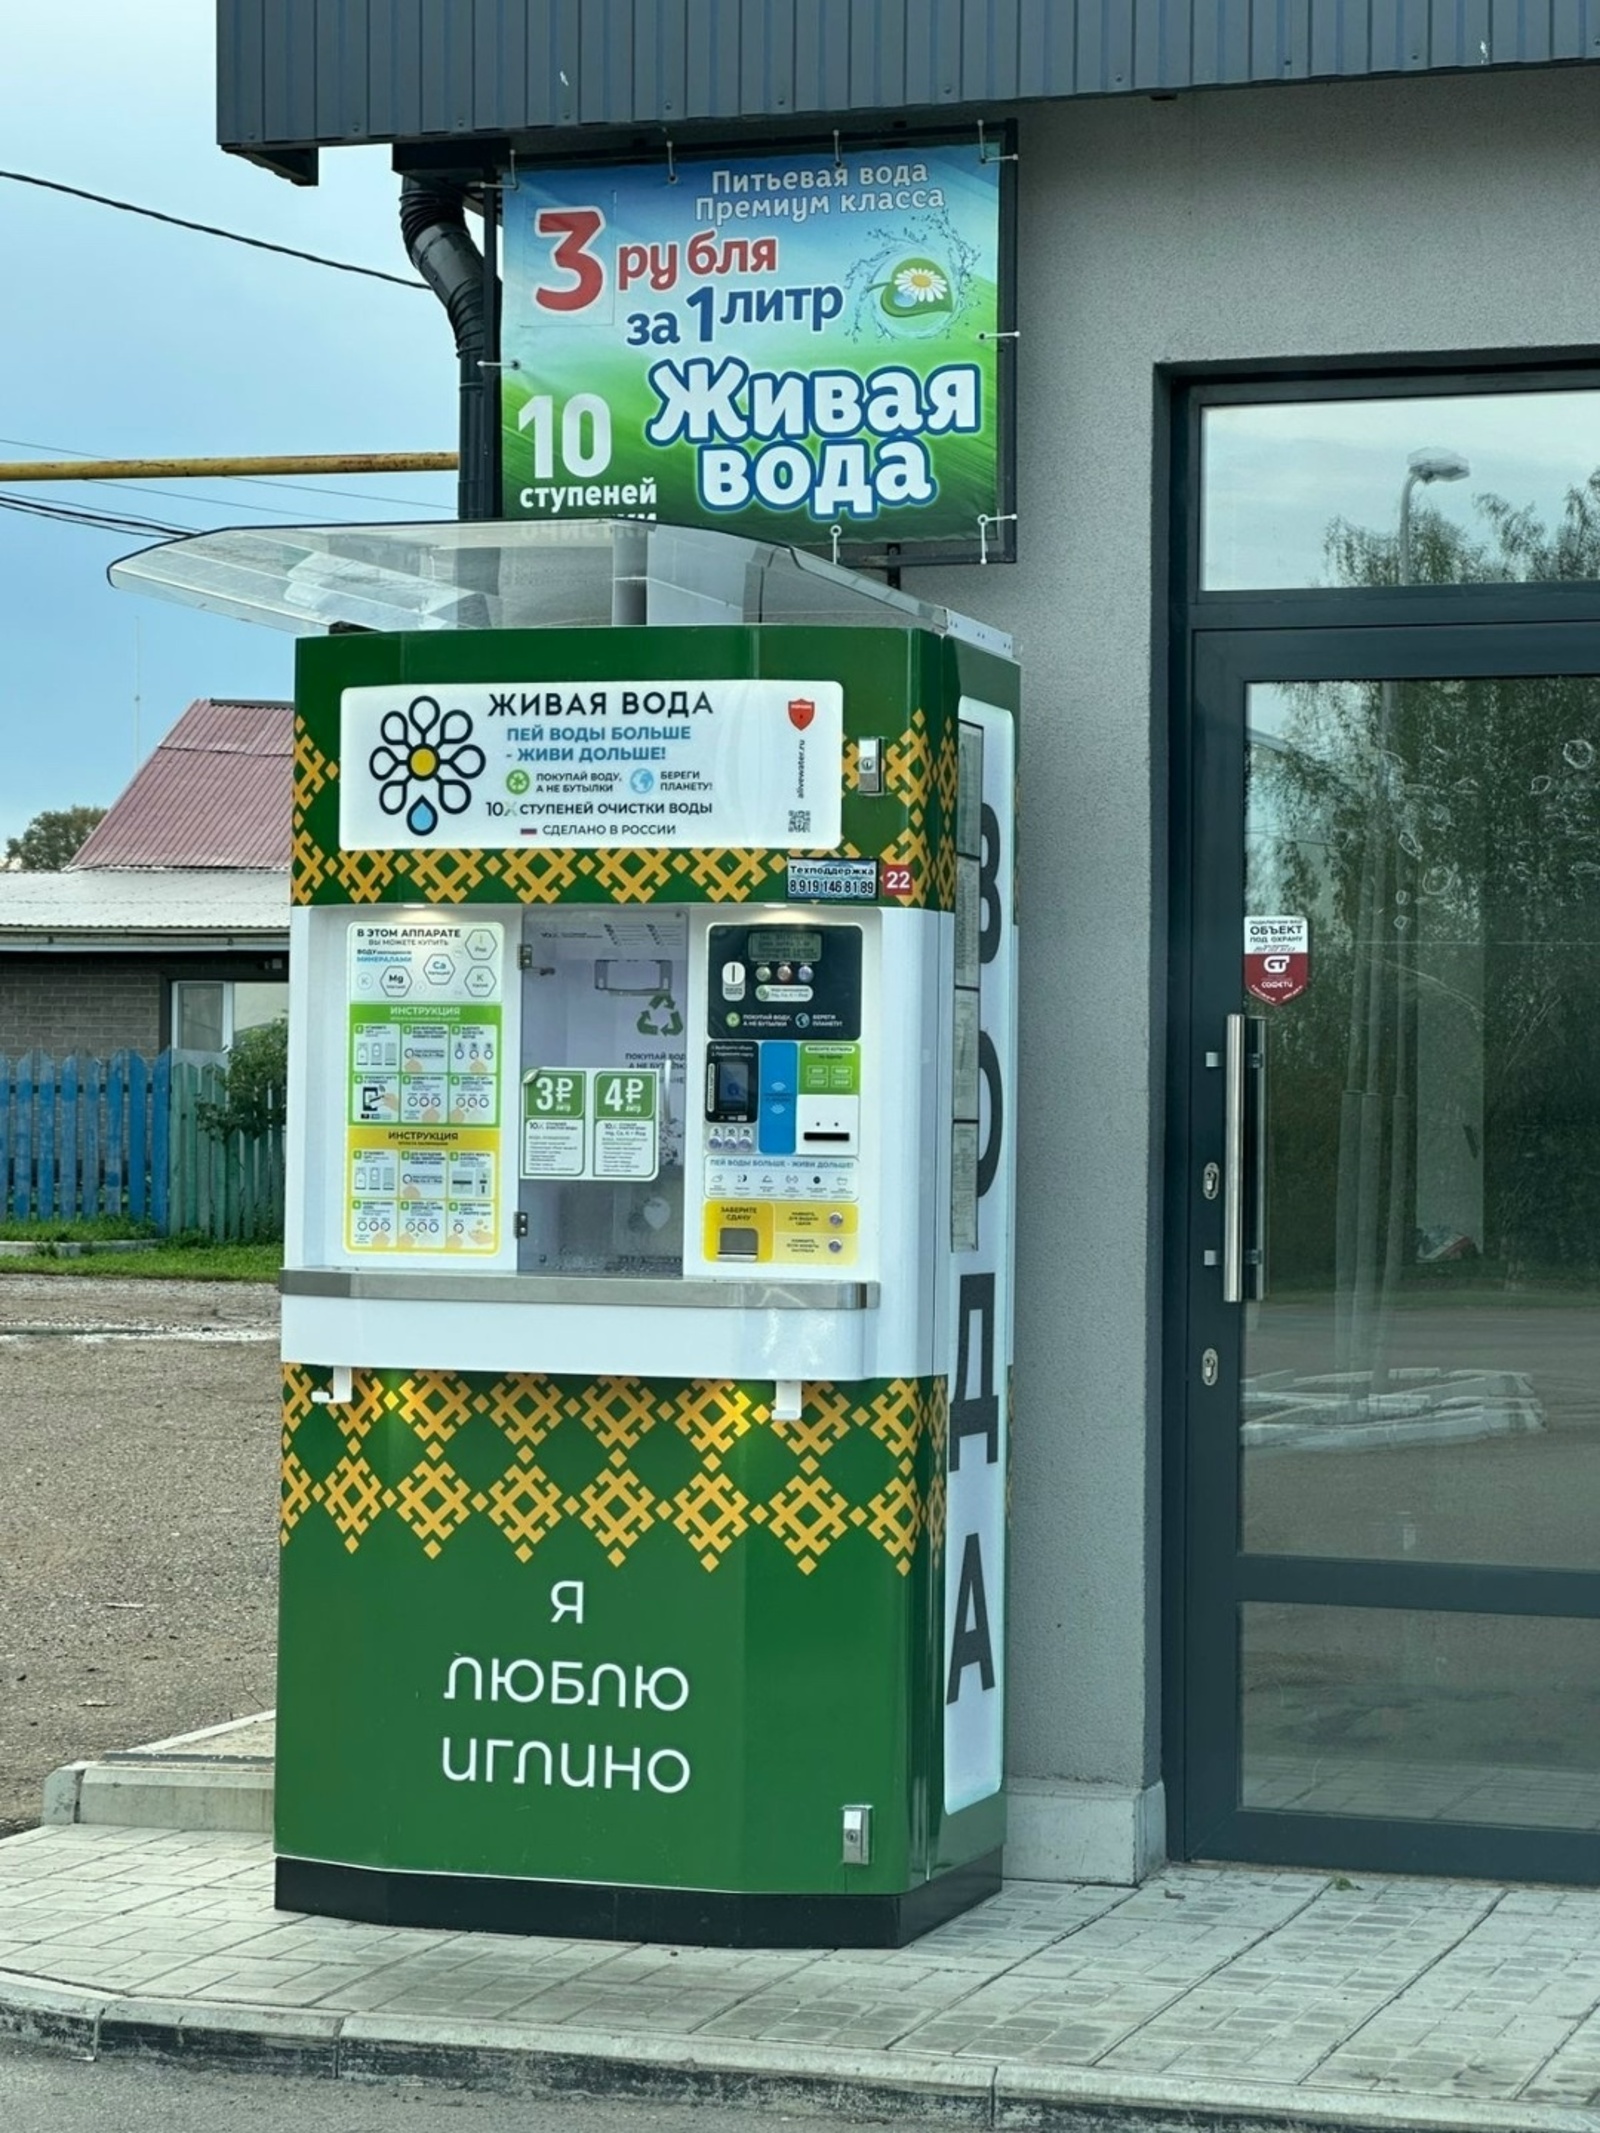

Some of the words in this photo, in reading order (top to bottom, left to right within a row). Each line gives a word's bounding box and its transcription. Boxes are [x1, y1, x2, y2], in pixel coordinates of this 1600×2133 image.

[711, 168, 848, 194] Питьевая
[859, 163, 928, 186] вода
[695, 197, 829, 225] Премиум
[840, 189, 944, 214] класса
[535, 208, 604, 311] 3
[617, 231, 778, 291] рубля
[626, 313, 681, 346] за
[686, 287, 714, 341] 1
[720, 286, 843, 331] литр
[648, 358, 980, 444] Живая
[518, 394, 611, 479] 10
[700, 440, 934, 518] вода
[519, 477, 658, 513] ступеней
[487, 692, 607, 716] ЖИВАЯ
[622, 691, 713, 718] ВОДА
[507, 725, 543, 741] ПЕЙ
[550, 727, 605, 743] ВОДЫ
[611, 726, 691, 740] БОЛЬШЕ
[517, 747, 574, 762] ЖИВИ
[579, 747, 666, 762] ДОЛЬШЕ!
[536, 771, 587, 781] ПОКУПАЙ
[590, 772, 622, 782] ВОДУ,
[660, 771, 700, 780] БЕРЕГИ
[536, 785, 544, 793] А
[546, 784, 560, 793] НЕ
[562, 784, 613, 793] БУТЫЛКИ
[660, 782, 713, 791] ПЛАНЕТУ!
[520, 802, 593, 815] СТУПЕНЕЙ
[597, 803, 665, 814] ОЧИСТКИ
[669, 802, 713, 815] ВОДЫ
[542, 824, 607, 836] СДЕЛАНО
[610, 824, 618, 834] В
[622, 824, 676, 835] РОССИИ
[791, 865, 875, 876] Техподдержка
[790, 880, 797, 892] 8
[799, 880, 820, 893] 919
[824, 881, 842, 893] 146
[845, 881, 858, 894] 81
[860, 881, 874, 894] 89
[886, 871, 911, 889] 22
[357, 929, 364, 937] В
[367, 929, 398, 937] ЭТОМ
[400, 929, 461, 938] АППАРАТЕ
[1250, 926, 1303, 935] ОБЪЕКТ
[433, 961, 446, 970] Ca
[389, 975, 404, 984] Mg
[390, 1006, 461, 1016] ИНСТРУКЦИЯ
[625, 1052, 666, 1060] ПОКУПАЙ
[388, 1131, 459, 1141] ИНСТРУКЦИЯ
[728, 1159, 751, 1167] ВОДЫ
[550, 1580, 584, 1624] Я
[443, 1656, 689, 1711] ЛЮБЛЮ
[442, 1737, 690, 1793] ИГЛИНО
